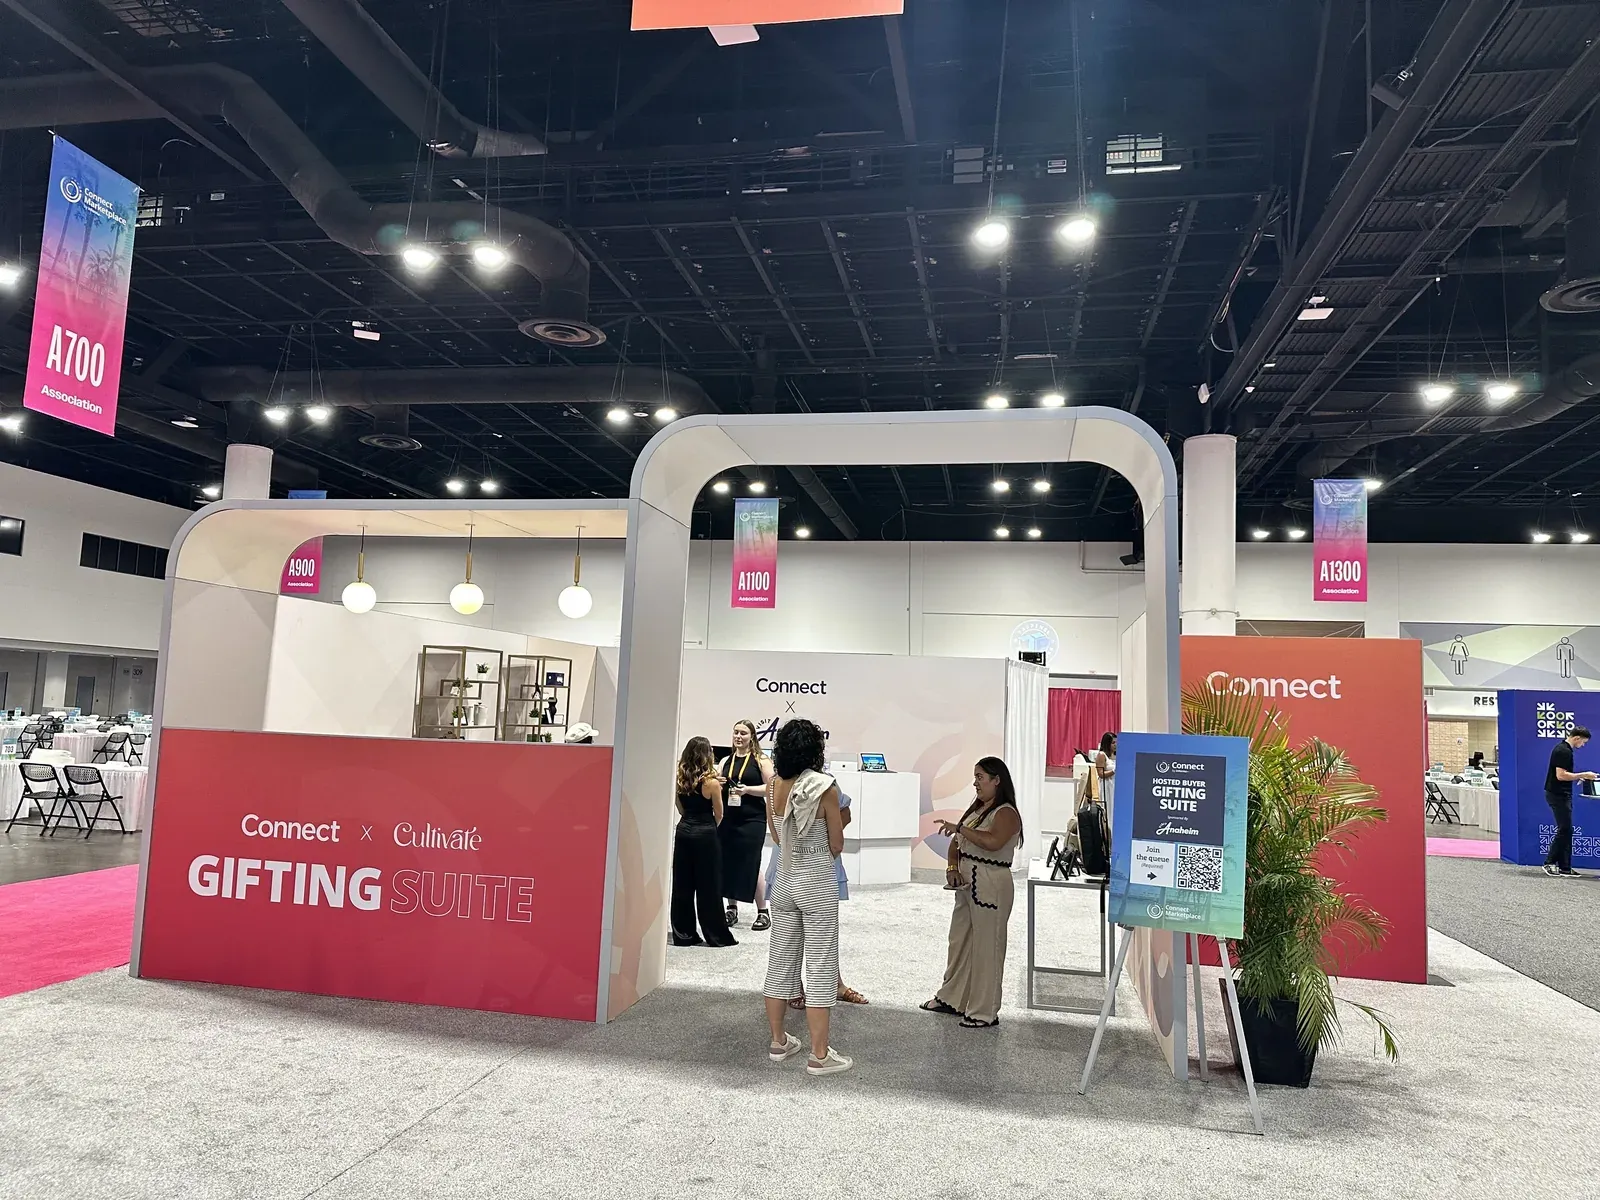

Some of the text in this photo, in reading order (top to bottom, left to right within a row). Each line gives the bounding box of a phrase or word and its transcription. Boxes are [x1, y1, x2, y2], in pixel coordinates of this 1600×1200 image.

[84, 187, 113, 210] Connect
[84, 196, 127, 226] Marketplace
[45, 324, 105, 387] A700
[41, 384, 102, 414] Association
[288, 558, 315, 577] A900
[1319, 560, 1361, 582] A1300
[738, 571, 770, 591] A1100
[756, 677, 827, 695] Connect
[1206, 670, 1342, 700] Connect
[1473, 696, 1498, 706] RES
[755, 718, 772, 730] VISIT
[1171, 761, 1205, 771] Connect
[1152, 777, 1206, 788] HOSTED BUYER
[1152, 786, 1206, 800] GIFTING
[1159, 798, 1197, 812] SUITE
[240, 813, 340, 843] Connect
[1156, 821, 1199, 835] Anaheim
[1146, 845, 1161, 854] Join
[1136, 853, 1170, 863] the queue
[1140, 862, 1164, 870] (Required)
[188, 854, 535, 923] GIFTING SUITE
[1165, 904, 1190, 913] Connect
[1165, 910, 1202, 920] Marketplace
